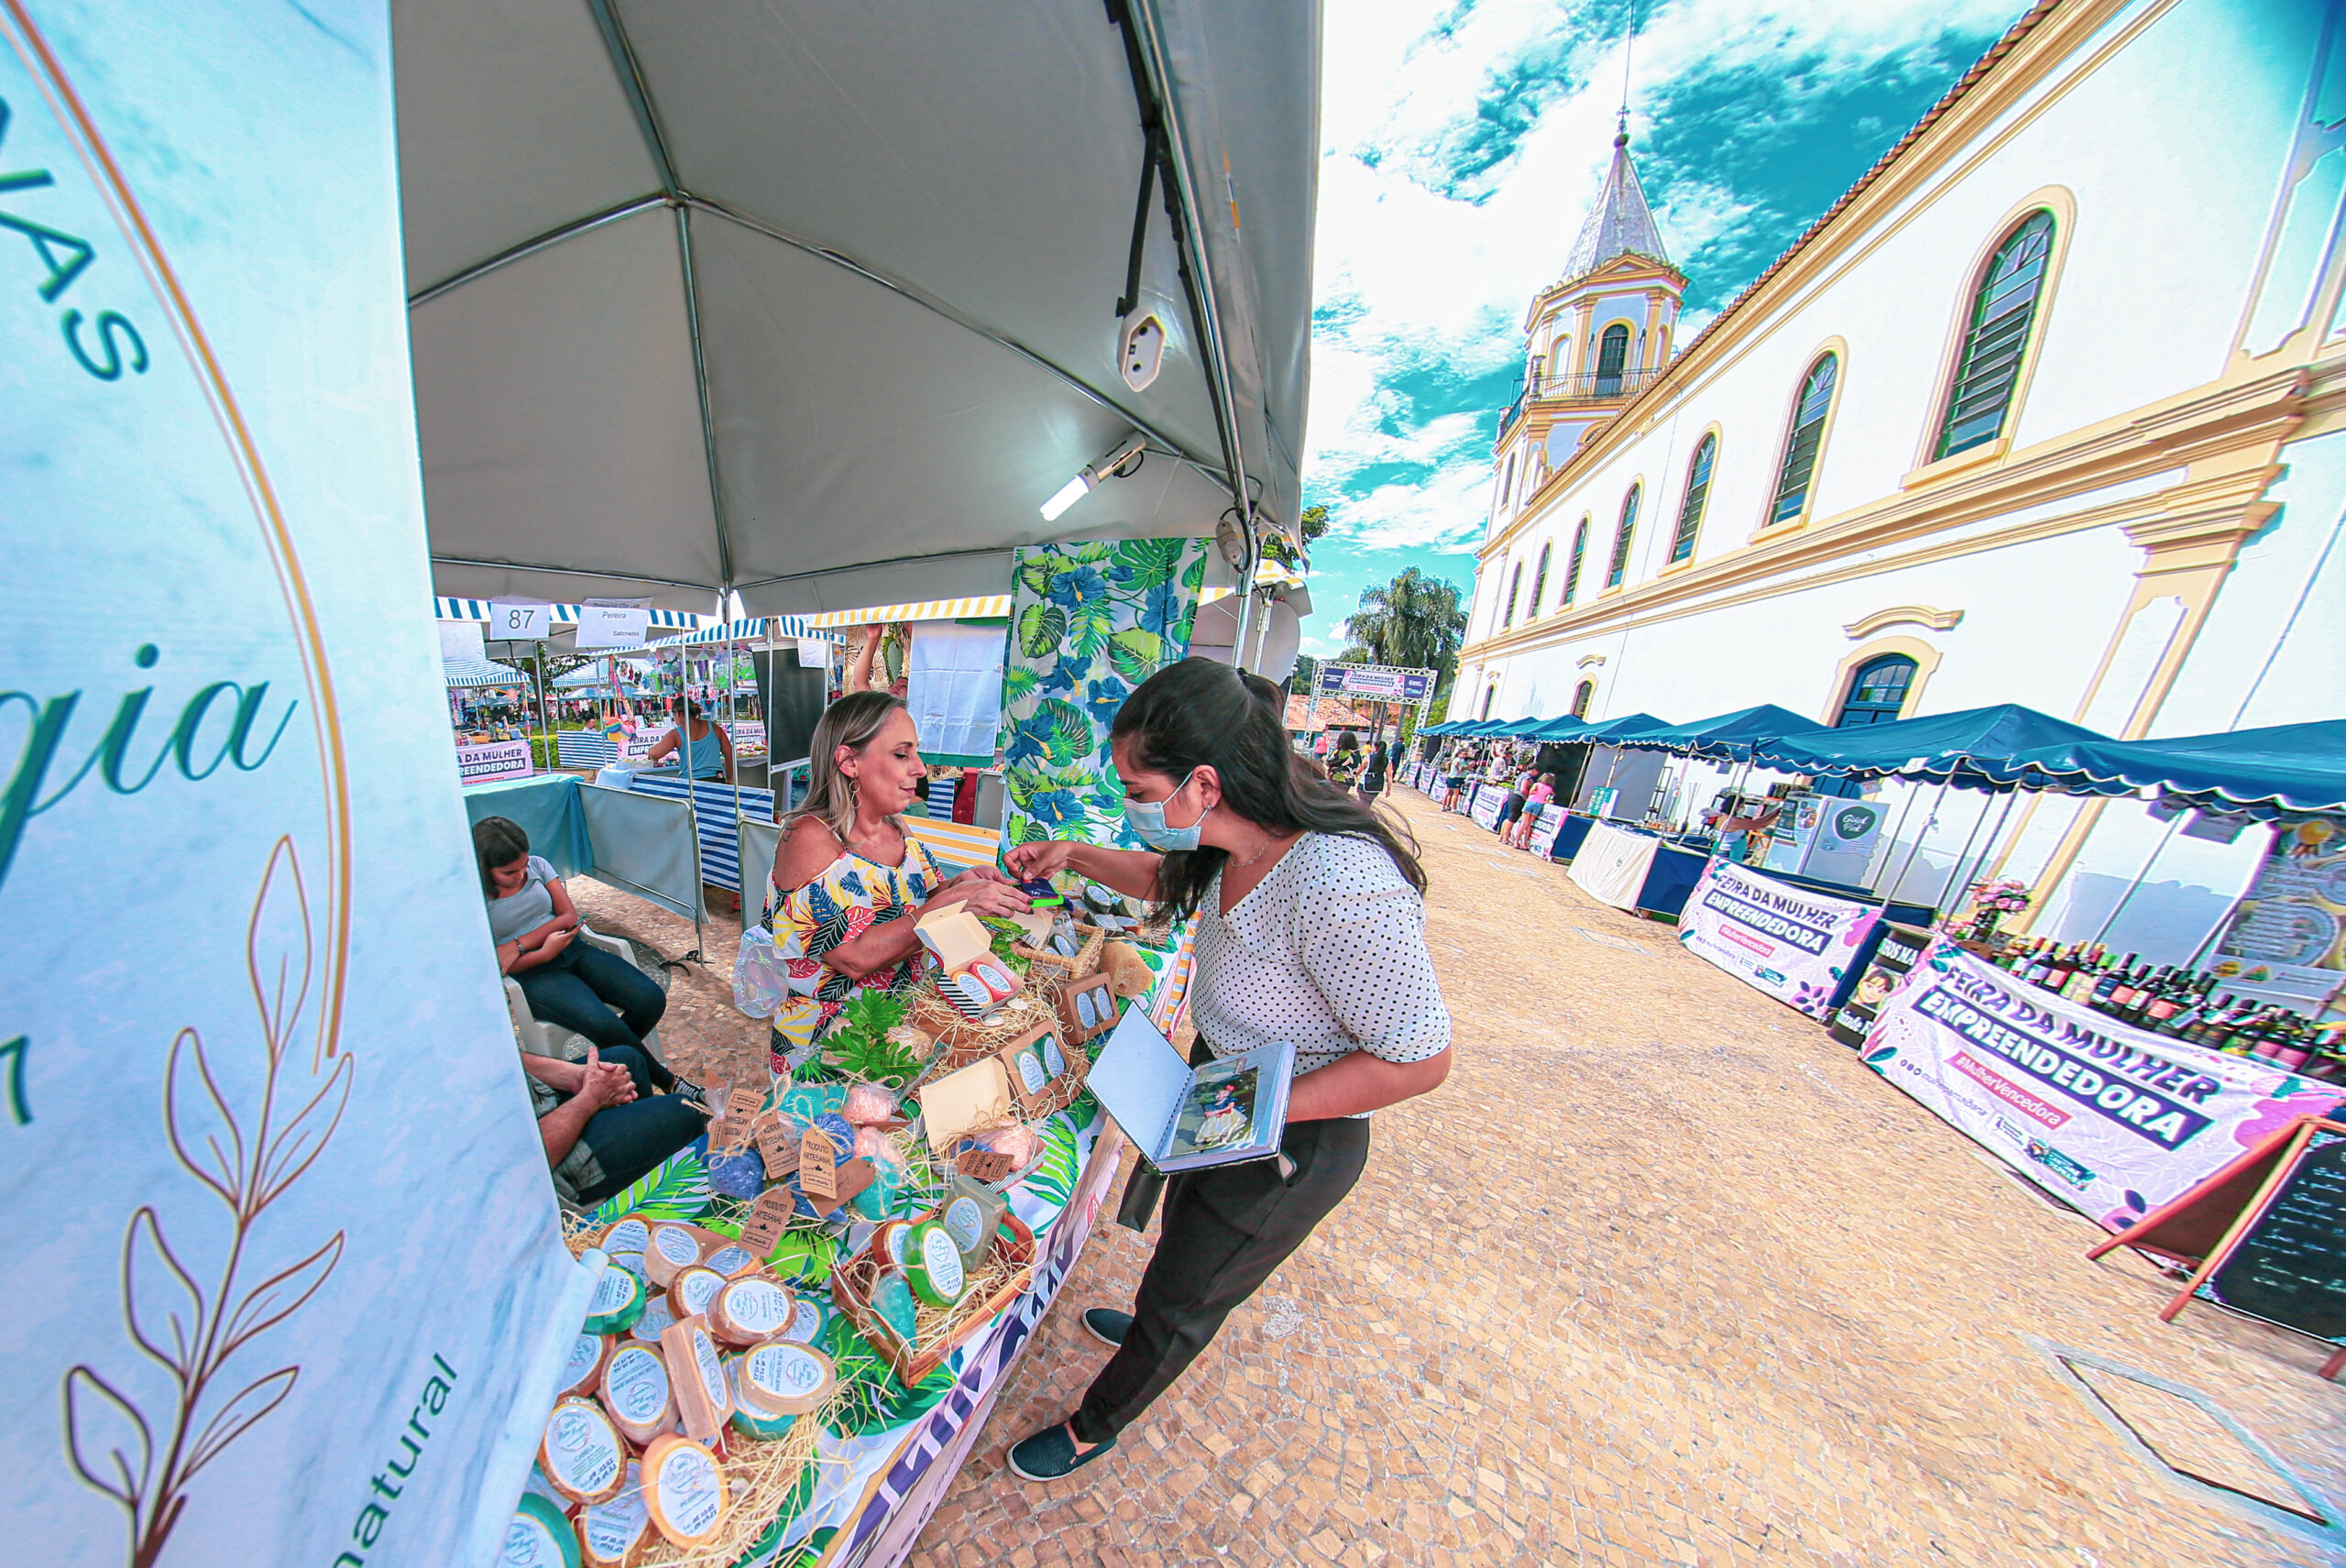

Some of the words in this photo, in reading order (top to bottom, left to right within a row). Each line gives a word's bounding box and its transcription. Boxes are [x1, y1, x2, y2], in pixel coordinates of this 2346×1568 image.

[508, 609, 535, 630] 87
[601, 610, 627, 620] Pereira
[612, 630, 640, 638] Sabonetes
[466, 753, 480, 762] DA
[482, 749, 522, 761] MULHER
[1716, 874, 1749, 898] FEIRA
[1752, 887, 1770, 906] DA
[1773, 895, 1839, 929] MULHER
[1706, 892, 1825, 952] EMPREENDEDORA
[1941, 967, 2012, 1012] FEIRA
[2008, 1003, 2055, 1034] DA
[2057, 1023, 2222, 1105] MULHER
[1919, 992, 2188, 1142] EMPREENDEDORA
[1956, 1056, 2062, 1125] #MulherVencedora
[806, 1140, 829, 1153] PRODUTO
[803, 1152, 832, 1167] ARTESANAL
[762, 1199, 788, 1212] PRODUTO
[754, 1210, 784, 1225] ARTESANAL
